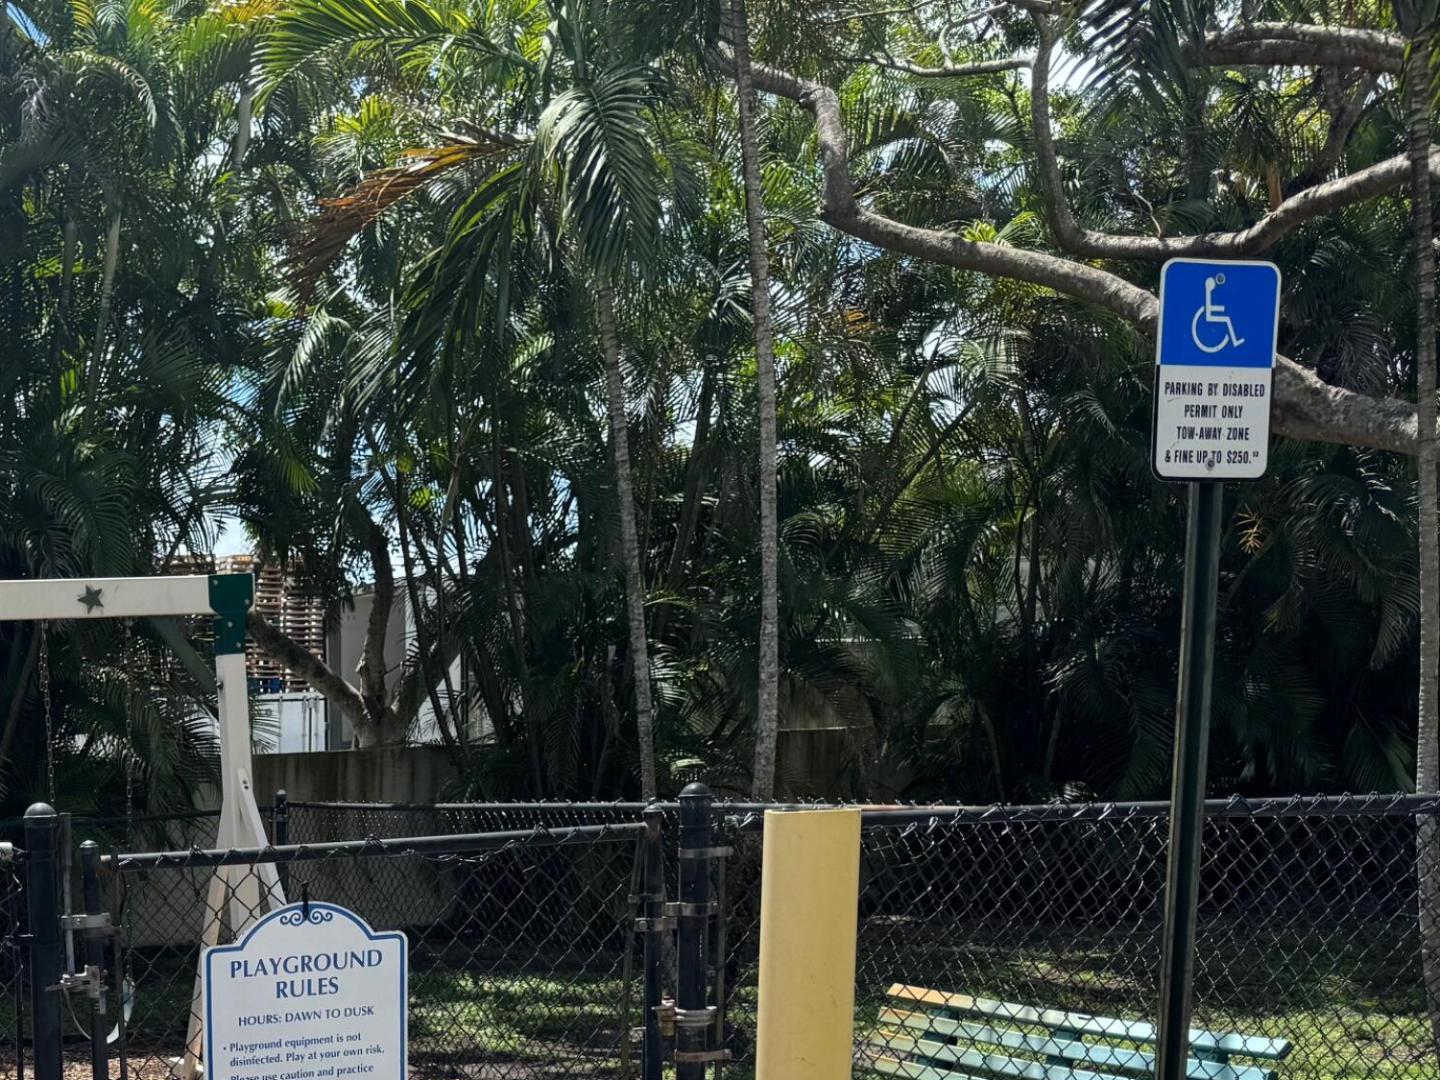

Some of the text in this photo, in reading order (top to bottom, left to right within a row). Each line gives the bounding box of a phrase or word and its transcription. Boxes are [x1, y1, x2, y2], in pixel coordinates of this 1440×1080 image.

[1165, 382, 1265, 397] PARKING BY DISABLED
[1184, 405, 1243, 418] PERMIT ONLY
[1177, 426, 1249, 440] TOW-AWAY ZONE
[1165, 450, 1171, 463] &
[1174, 450, 1193, 463] FINE
[1197, 451, 1208, 463] UP
[1211, 451, 1221, 463] TO
[230, 949, 382, 978] PLAYGROUND
[276, 977, 338, 998] RULES
[239, 1005, 374, 1027] HOURS: DAWN TO DUSK
[230, 1032, 362, 1053] Playground equipment is not
[230, 1044, 384, 1067] disinfected. Play at your own risk.
[280, 1068, 314, 1080] caution
[317, 1066, 334, 1076] and
[337, 1064, 374, 1078] practice
